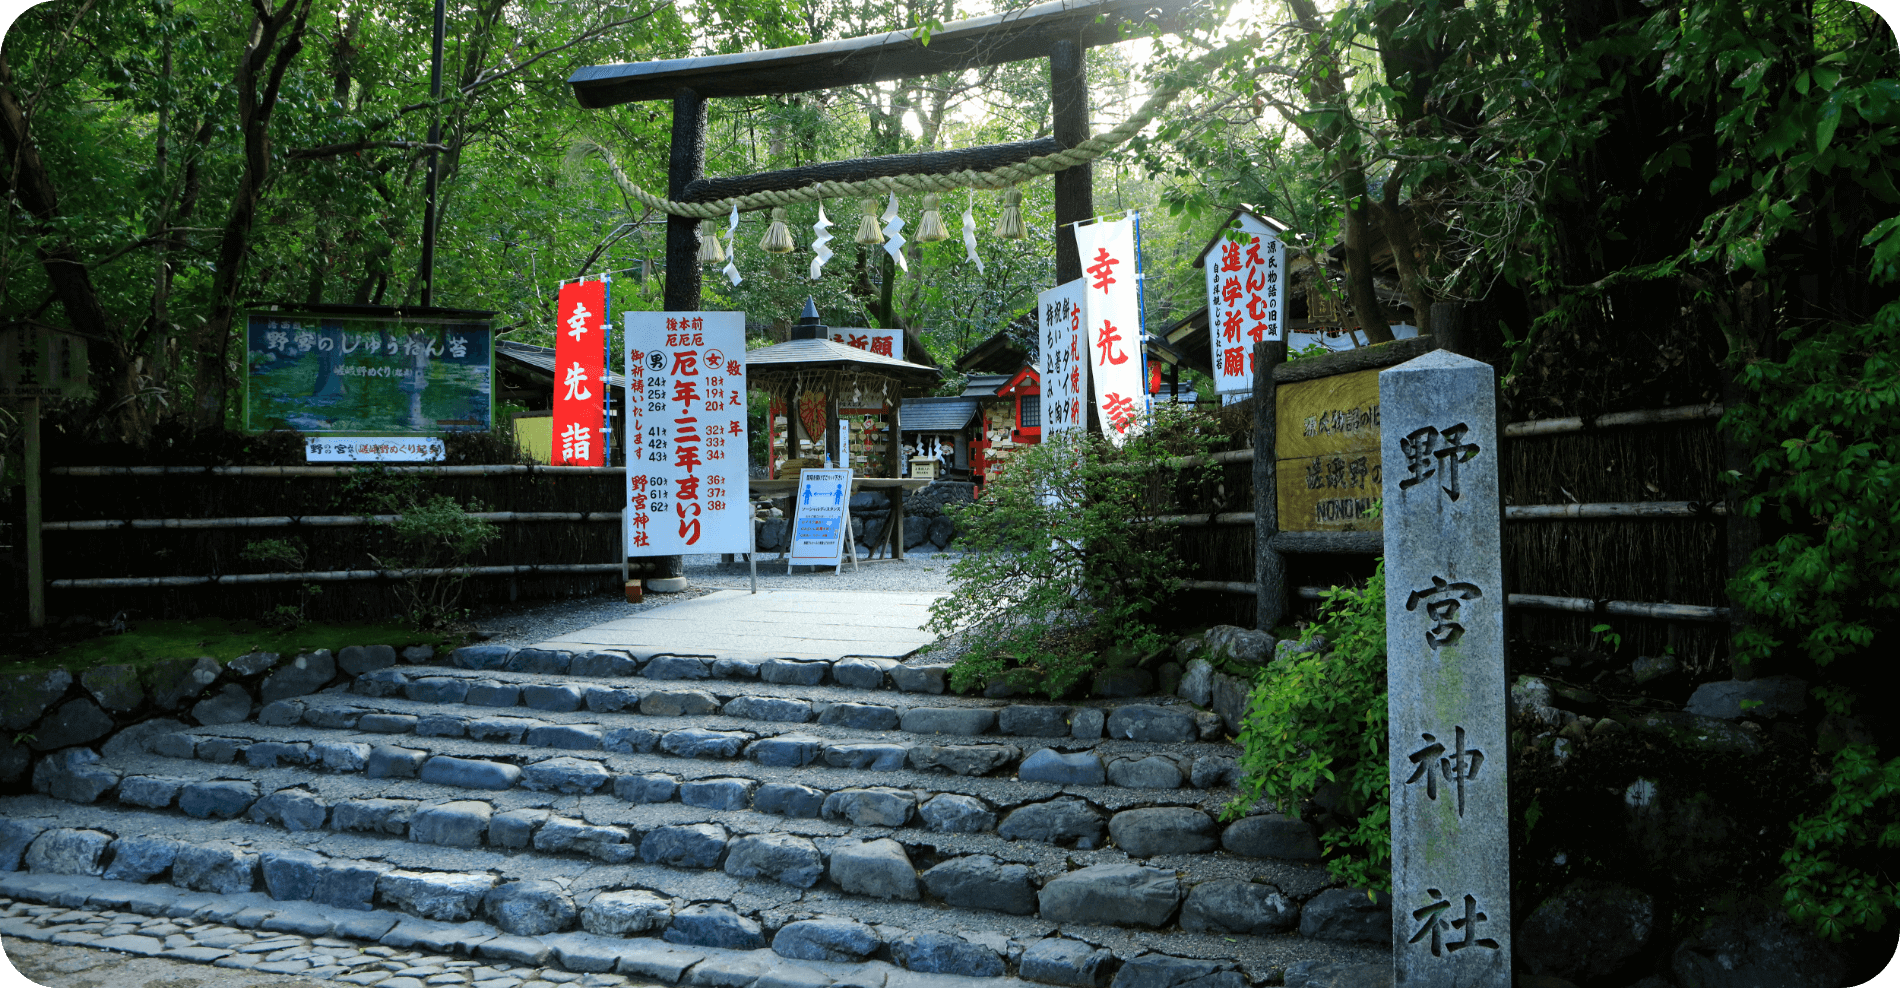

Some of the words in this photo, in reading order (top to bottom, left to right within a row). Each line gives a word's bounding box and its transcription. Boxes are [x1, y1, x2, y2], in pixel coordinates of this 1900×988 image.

[1221, 241, 1244, 377] 進学祈願
[1246, 236, 1269, 374] えんむす
[1211, 262, 1223, 370] 自由拝観じゅうたん苔
[267, 331, 469, 358] 野宮のじゅうたん苔
[17, 349, 39, 385] 禁止
[561, 302, 592, 462] 幸先詣
[648, 377, 666, 387] 24才
[705, 377, 724, 387] 18才
[648, 390, 666, 399] 25才
[705, 389, 724, 398] 19才
[631, 349, 645, 460] 御祈祷いたします
[648, 402, 666, 412] 26才
[705, 401, 724, 411] 20才
[648, 427, 667, 437] 41才
[705, 426, 724, 435] 32才
[648, 439, 667, 449] 42才
[706, 438, 725, 447] 33才
[648, 452, 667, 462] 43才
[706, 450, 725, 460] 34才
[650, 477, 668, 486] 60才
[707, 476, 725, 485] 36才
[650, 490, 668, 499] 61才
[707, 488, 725, 497] 37才
[650, 502, 668, 512] 62才
[707, 501, 726, 511] 38才
[631, 475, 650, 548] 野宮神社
[1399, 421, 1499, 957] 野宮神社
